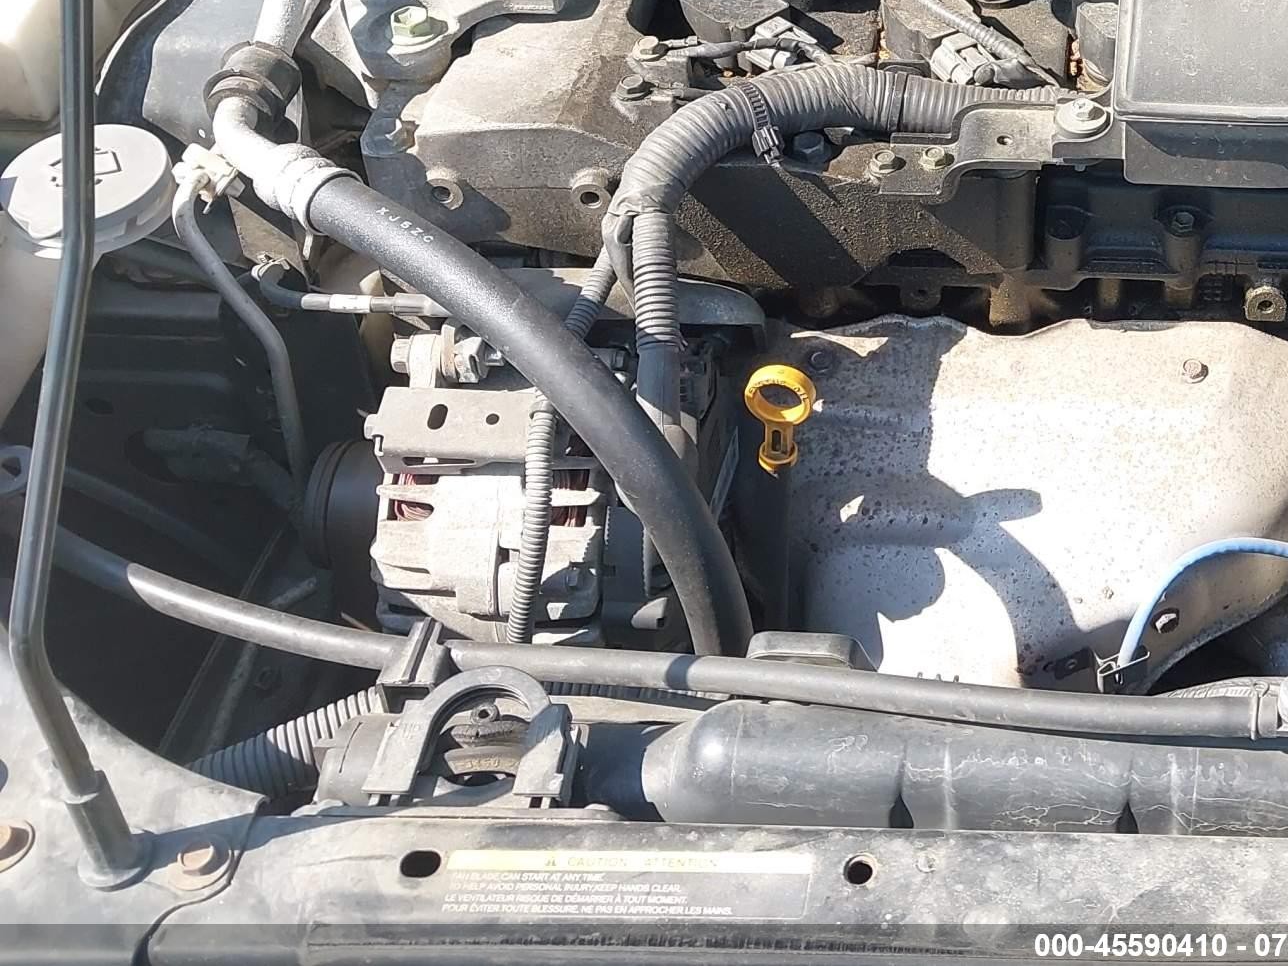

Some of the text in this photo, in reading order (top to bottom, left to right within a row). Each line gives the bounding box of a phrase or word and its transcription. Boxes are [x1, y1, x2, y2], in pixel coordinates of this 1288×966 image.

[567, 856, 627, 867] CAUTION
[500, 872, 521, 881] CAN
[521, 872, 550, 882] START
[550, 872, 561, 882] AT
[561, 872, 582, 882] ANY
[487, 883, 514, 892] AVOID
[515, 883, 562, 892] PERSONAL
[618, 884, 649, 893] HANDS
[445, 894, 456, 902] LE
[458, 894, 515, 903] VENTILATEUR
[516, 894, 549, 903] RISQUE
[550, 894, 563, 903] DE
[564, 893, 614, 904] DÉMARRER
[623, 895, 648, 904] TOUT
[442, 904, 468, 912] POUR
[469, 903, 501, 913] ÉVITER
[502, 905, 530, 914] TOUTE
[581, 905, 594, 914] NE
[595, 905, 613, 914] PAS
[614, 905, 627, 914] EN
[628, 905, 684, 915] APPROCHER
[685, 906, 702, 915] LES
